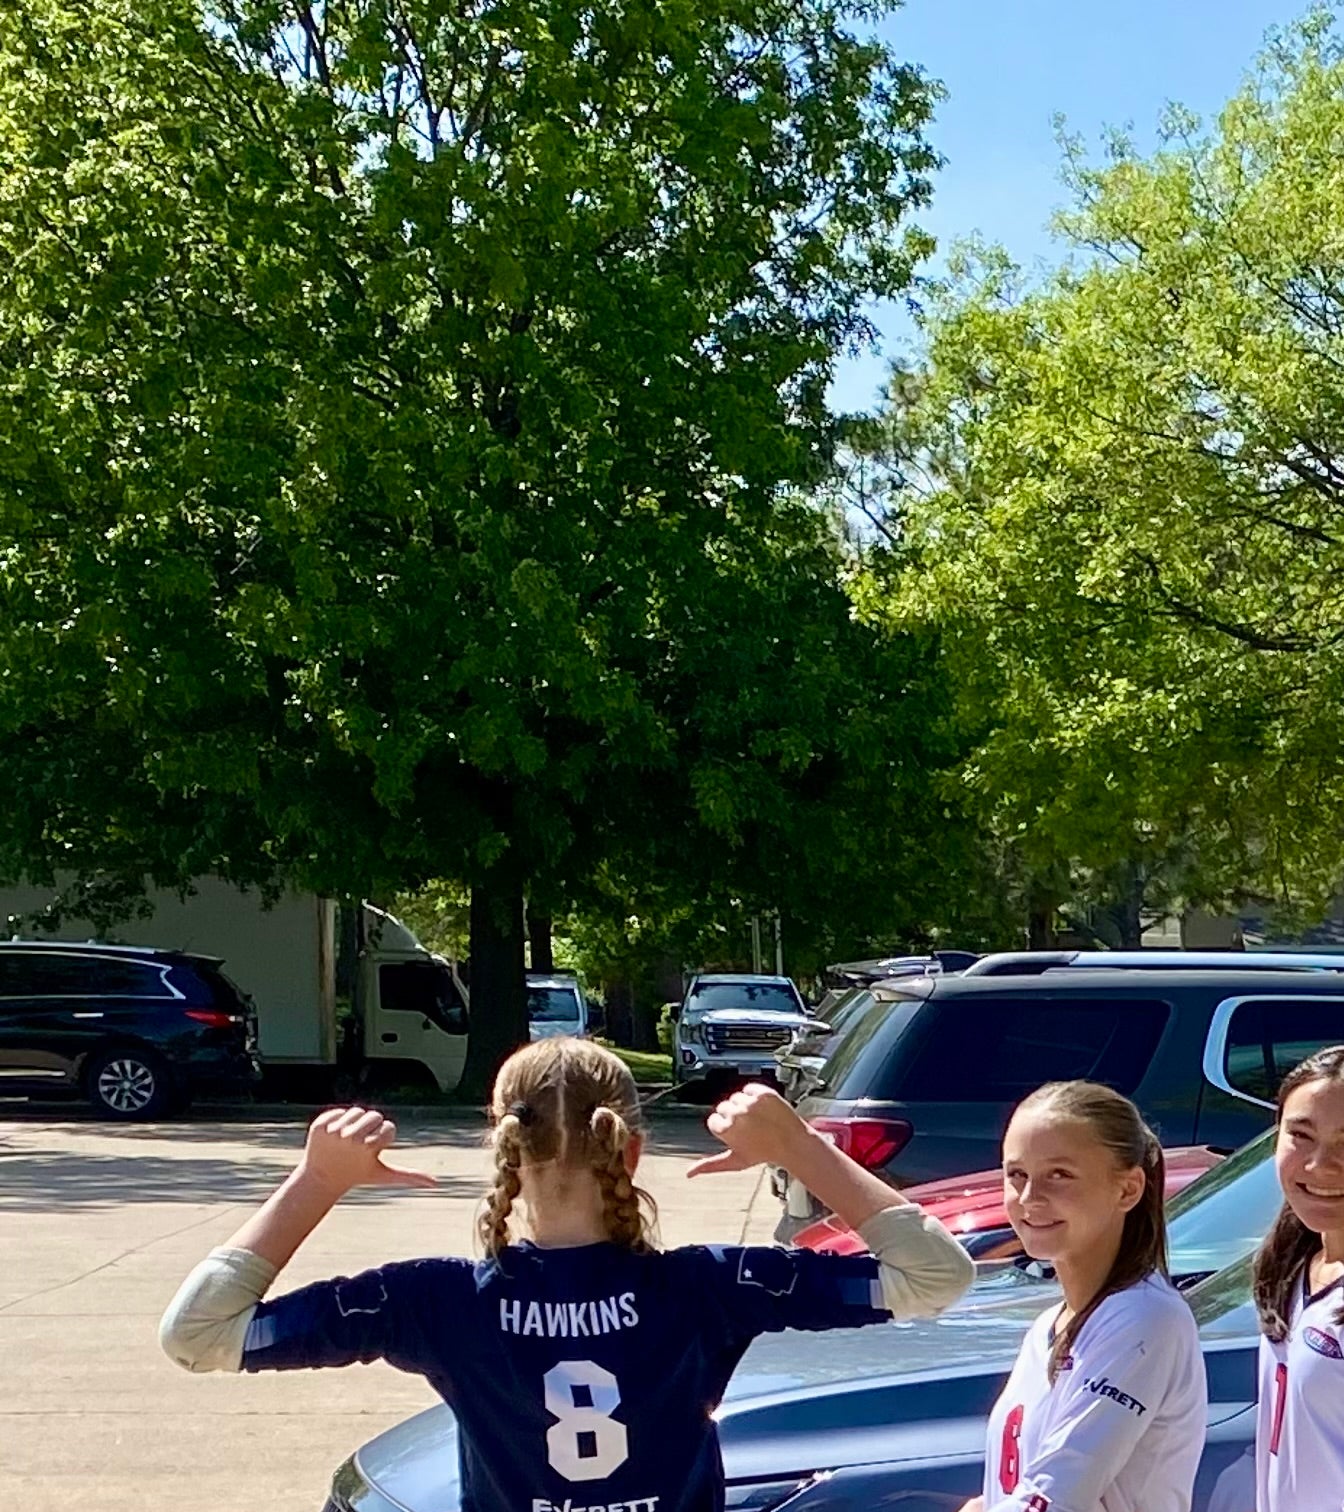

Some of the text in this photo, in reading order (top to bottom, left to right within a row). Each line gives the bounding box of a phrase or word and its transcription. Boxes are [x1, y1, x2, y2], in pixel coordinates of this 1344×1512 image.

[500, 1292, 640, 1338] HAWKINS
[543, 1360, 630, 1482] 8
[999, 1403, 1025, 1495] 6
